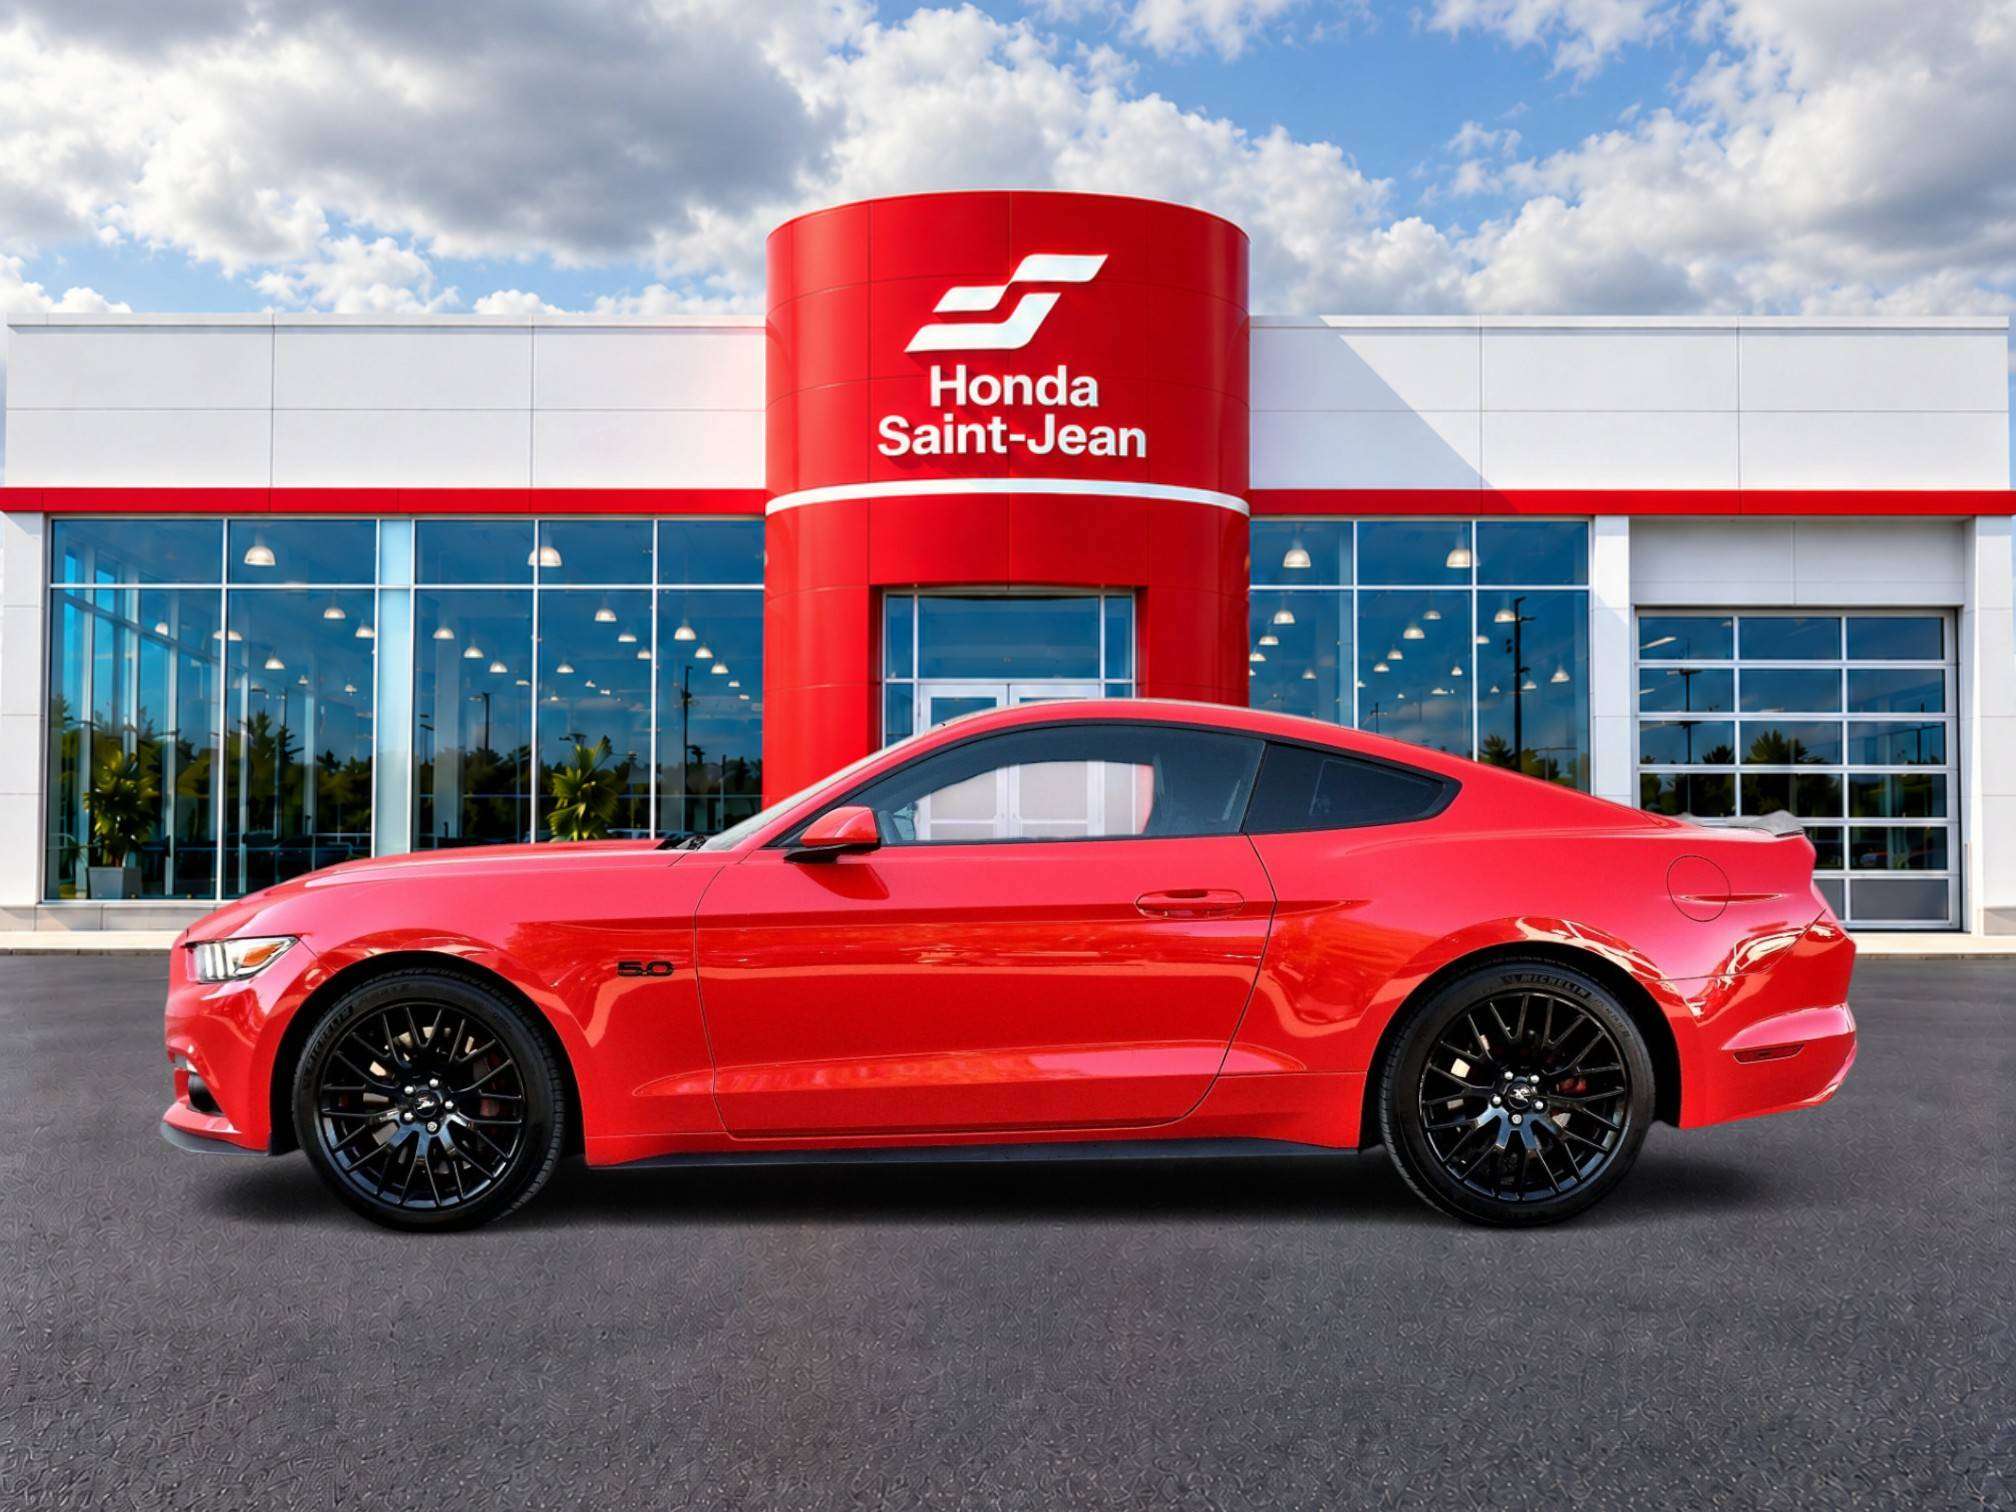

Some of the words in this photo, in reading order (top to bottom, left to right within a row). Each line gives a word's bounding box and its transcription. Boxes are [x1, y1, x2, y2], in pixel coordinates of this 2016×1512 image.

[930, 364, 1099, 407] Honda
[877, 413, 1147, 458] Saint-Jean
[617, 960, 674, 977] 5.0
[1519, 973, 1592, 998] MICHELIN
